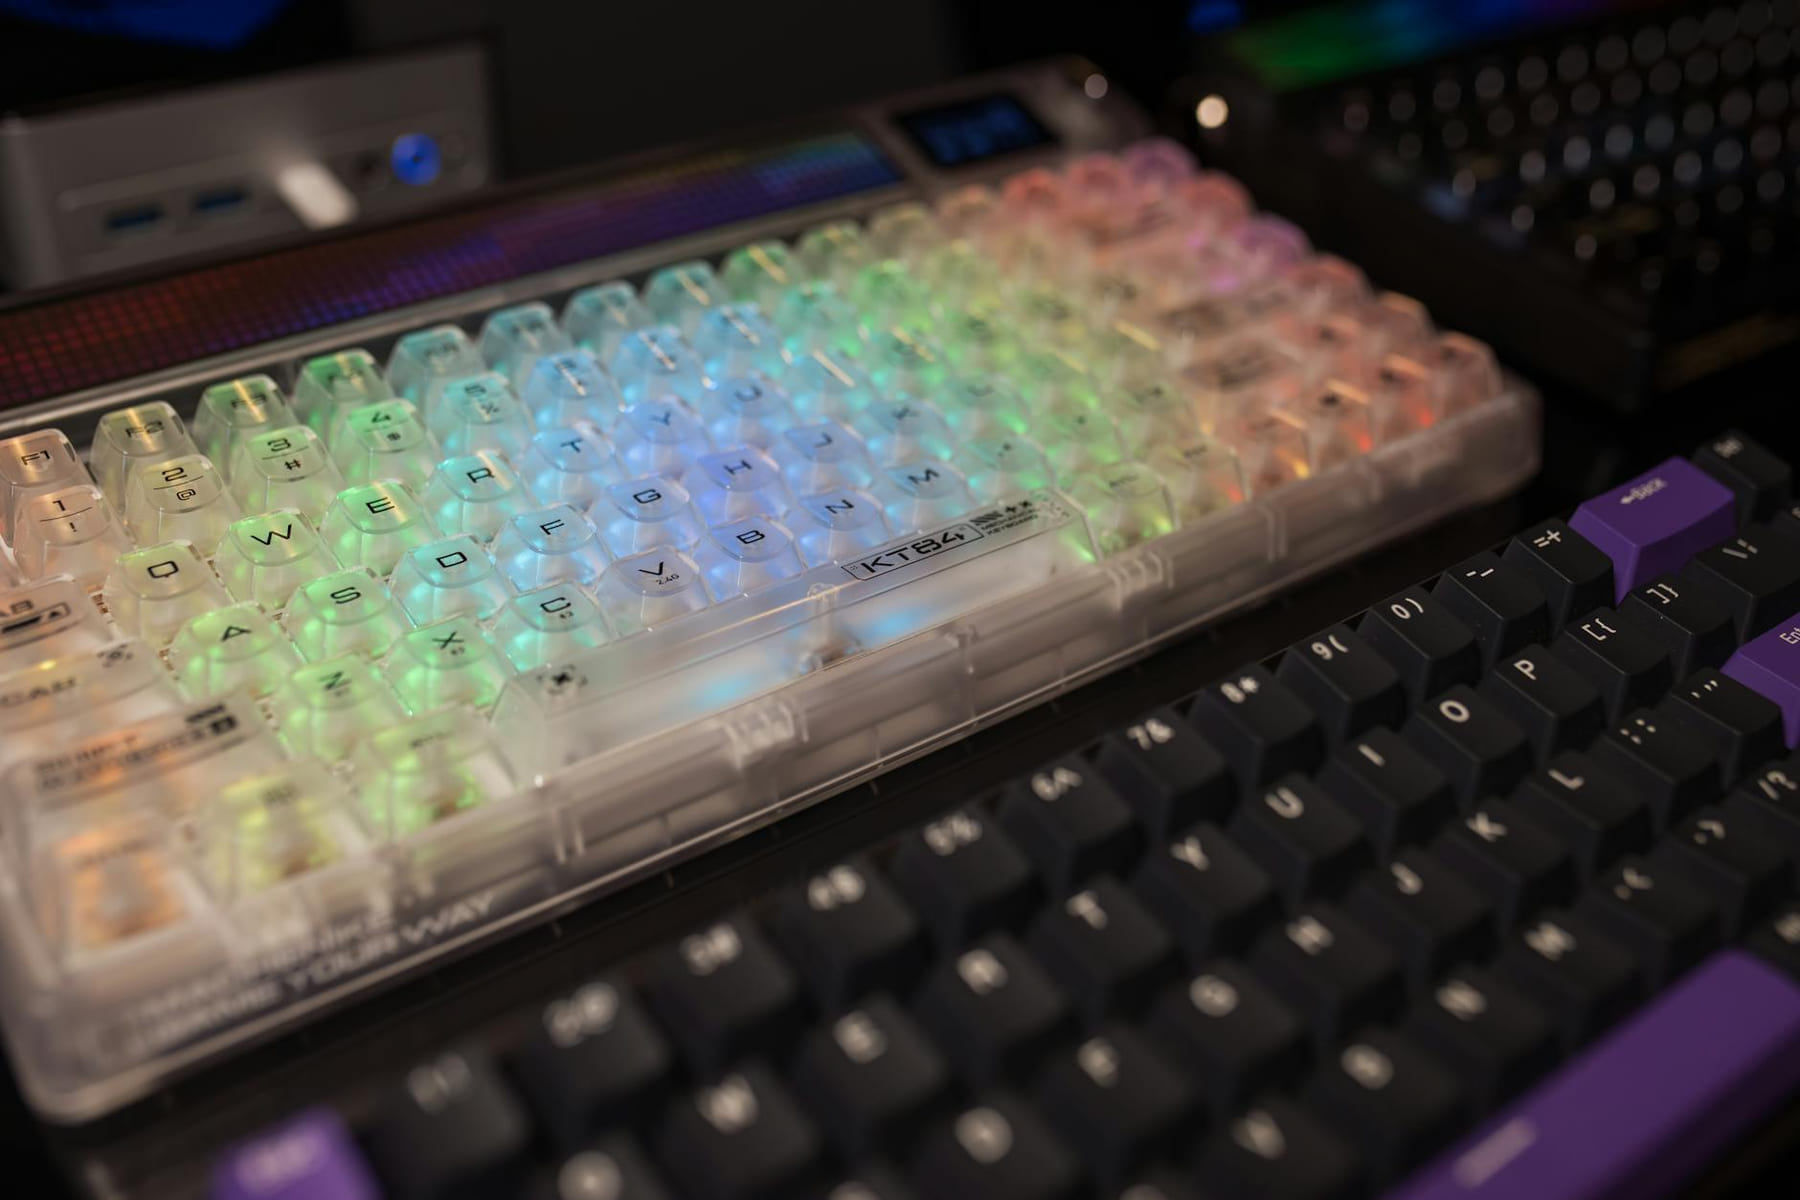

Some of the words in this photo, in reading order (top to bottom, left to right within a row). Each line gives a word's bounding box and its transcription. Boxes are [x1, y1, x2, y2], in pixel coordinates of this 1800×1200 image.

[267, 438, 291, 451] 3
[560, 438, 582, 453] T
[21, 450, 50, 465] F1
[284, 459, 301, 471] #
[162, 467, 187, 482] 2
[466, 467, 495, 483] R
[723, 460, 752, 475] H
[908, 468, 940, 485] M
[176, 488, 196, 500] @
[633, 489, 661, 504] G
[365, 497, 395, 514] E
[825, 499, 855, 514] N
[251, 524, 292, 546] W
[539, 519, 565, 535] F
[736, 529, 765, 545] B
[436, 551, 468, 568] D
[147, 560, 179, 578] Q
[638, 561, 664, 576] V
[330, 586, 361, 605] S
[540, 597, 571, 613] C
[221, 625, 251, 641] A
[432, 631, 464, 649] X
[1513, 659, 1537, 680] P
[1548, 769, 1585, 790] L
[1264, 787, 1304, 820] U
